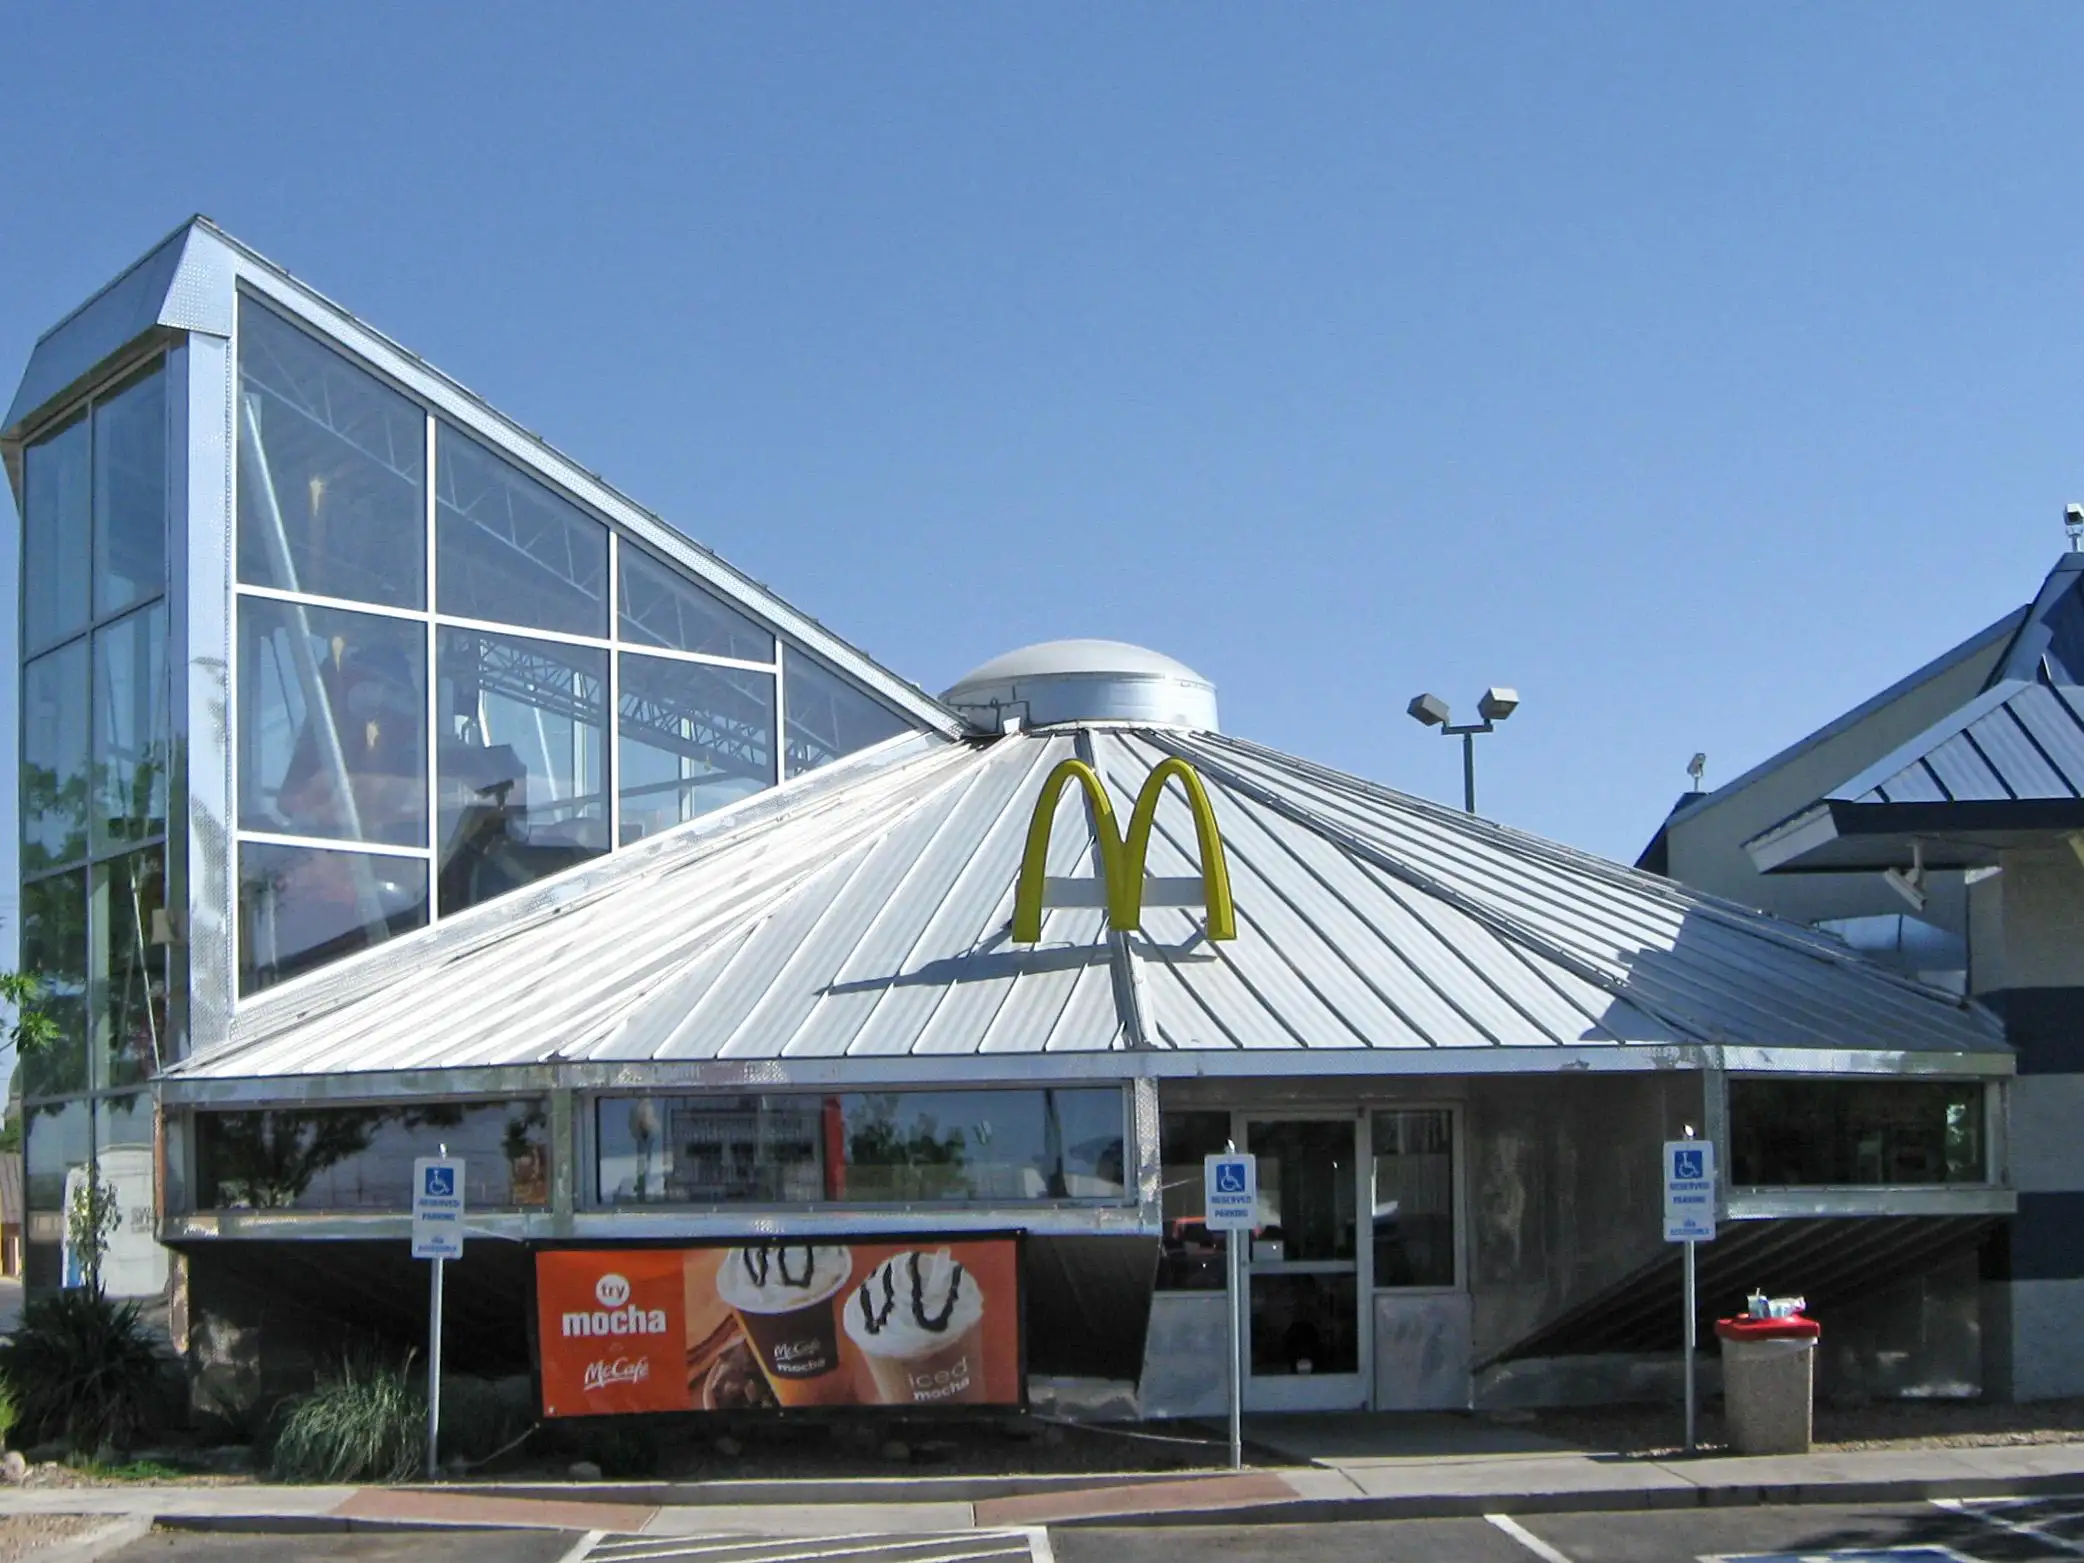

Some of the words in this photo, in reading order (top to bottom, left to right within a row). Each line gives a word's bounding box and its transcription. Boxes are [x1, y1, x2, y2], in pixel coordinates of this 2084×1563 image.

[1215, 1208, 1249, 1217] PARKING
[601, 1284, 625, 1299] try
[562, 1304, 666, 1337] mocha
[583, 1356, 649, 1391] McCafé
[776, 1358, 826, 1373] mocha
[913, 1377, 970, 1401] mocha
